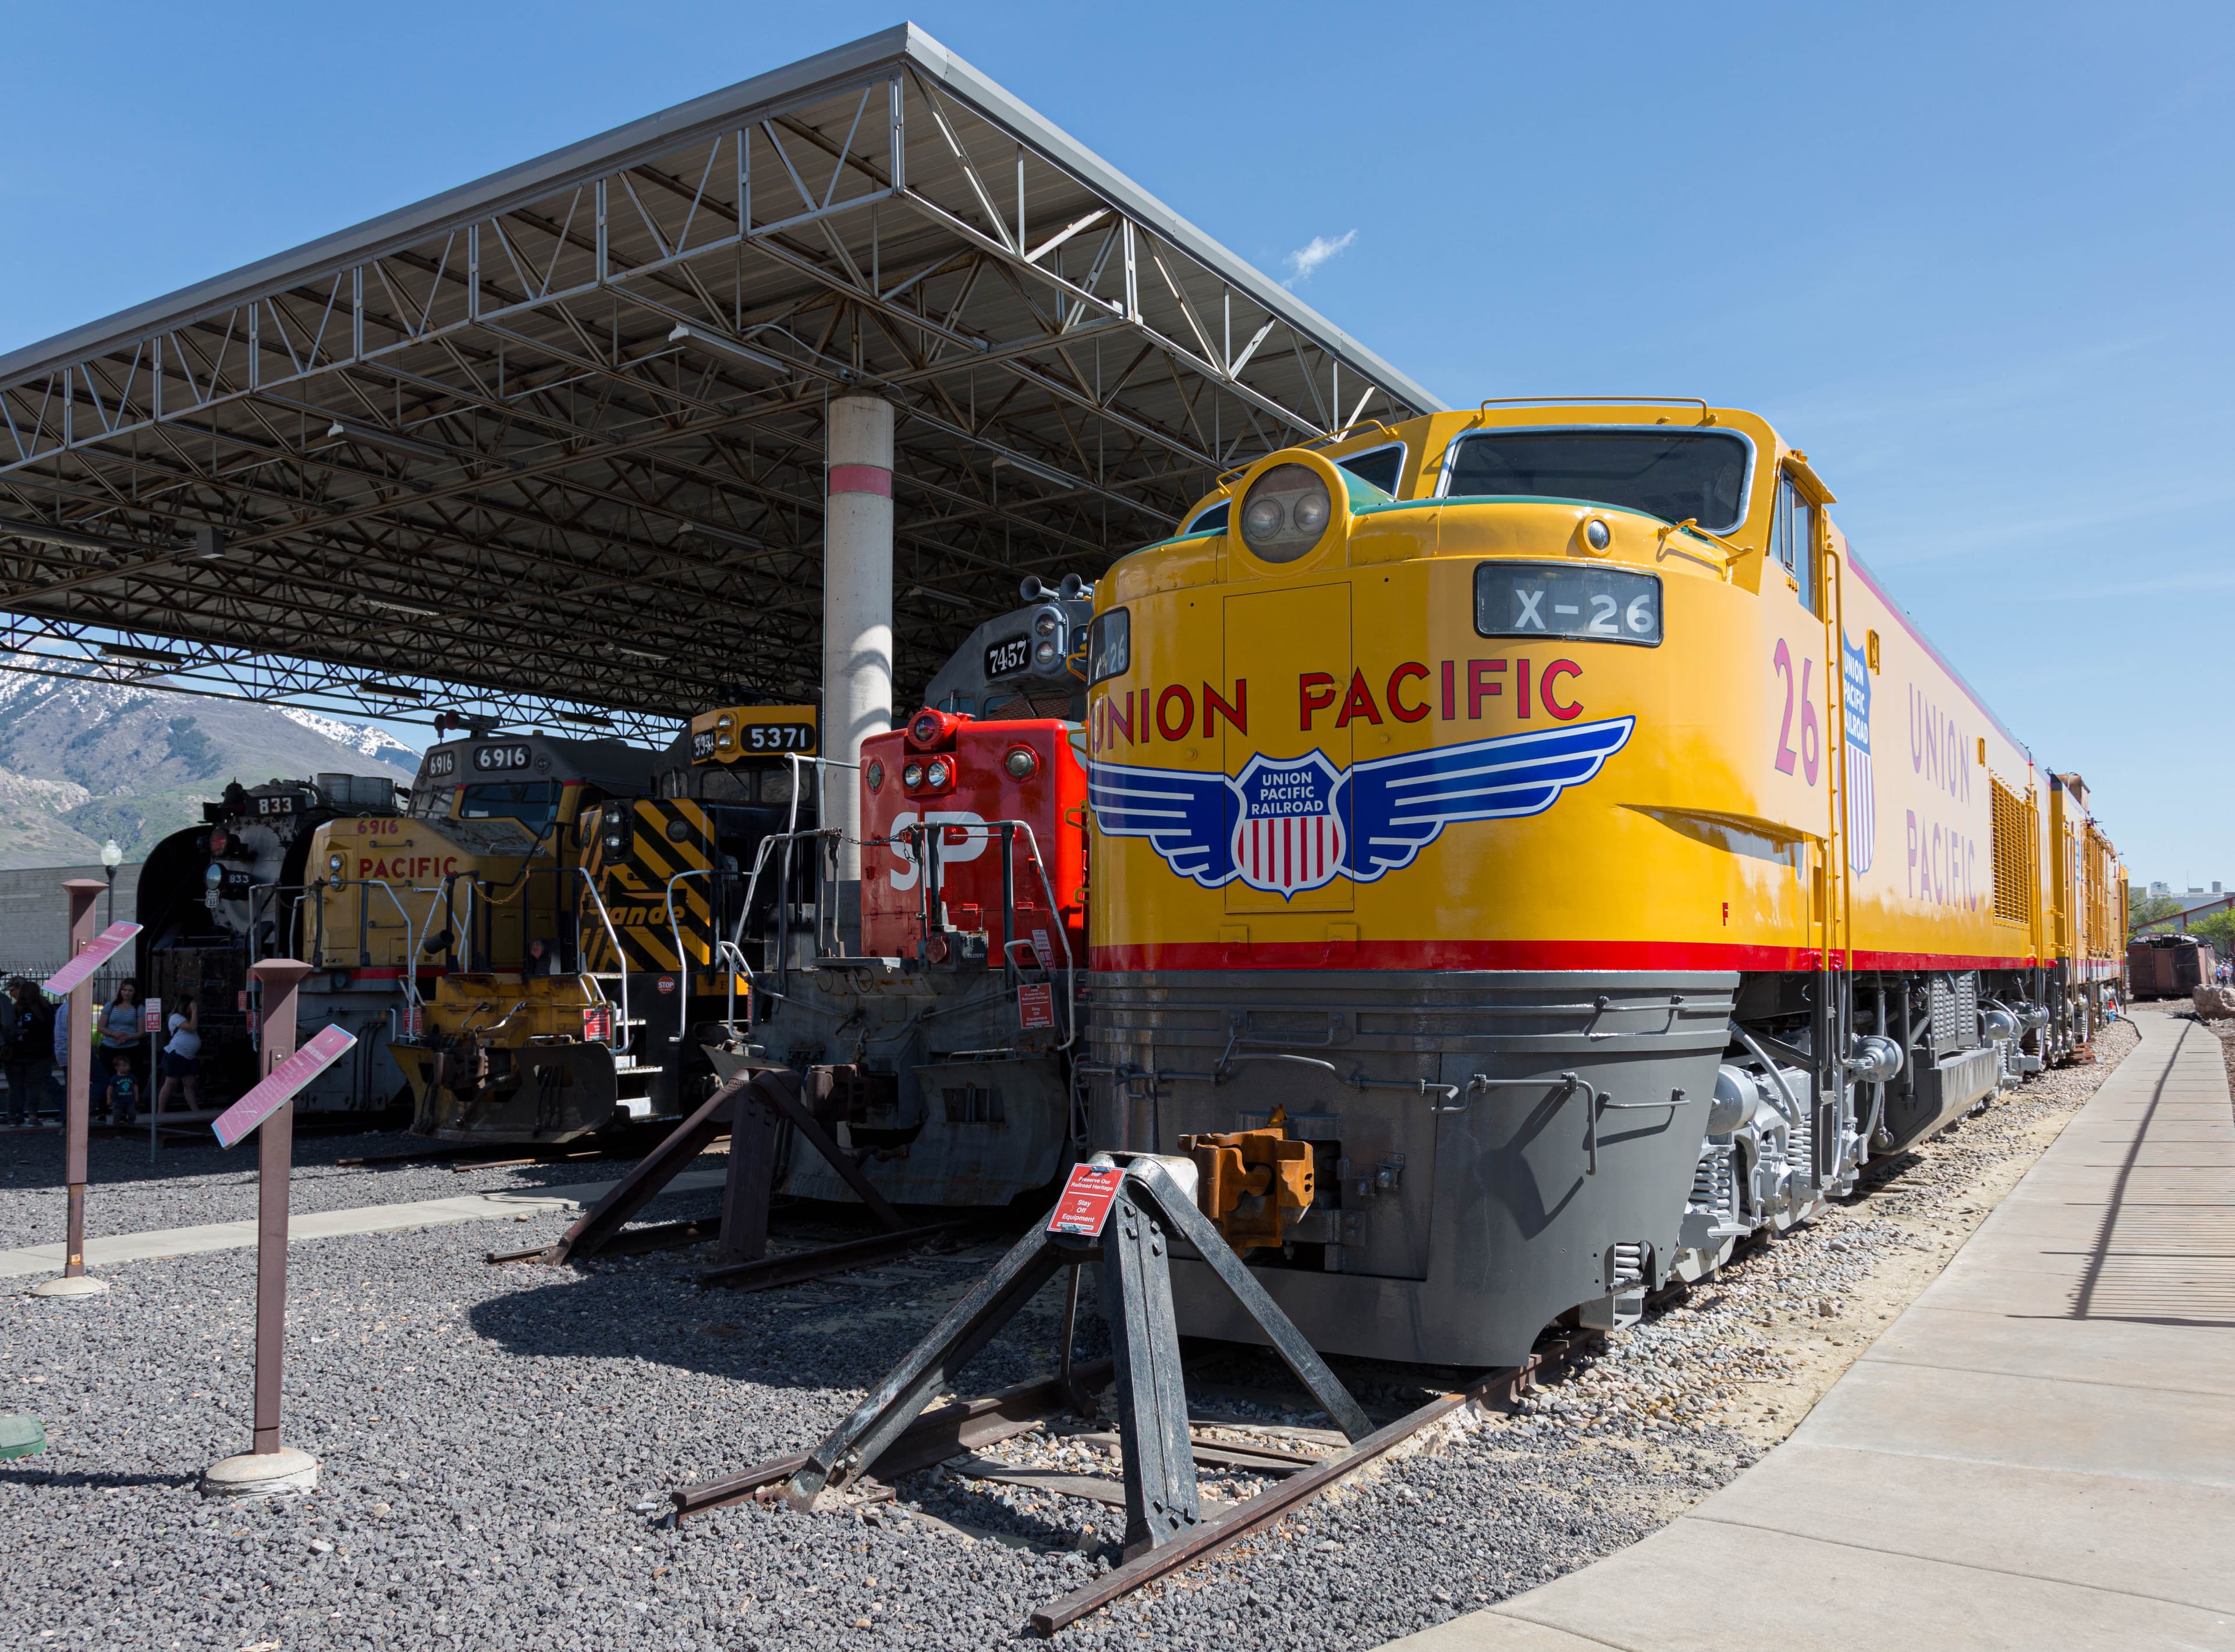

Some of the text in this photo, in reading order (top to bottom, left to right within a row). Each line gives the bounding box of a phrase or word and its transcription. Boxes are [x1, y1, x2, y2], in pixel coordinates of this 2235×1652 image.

[1514, 589, 1655, 634] X-26
[989, 640, 1027, 674] 7457
[1844, 650, 1864, 687] UNION
[1091, 659, 1584, 755] UNION PACIFIC
[1843, 678, 1865, 715] PACIFIC
[1773, 638, 1819, 787] 26
[751, 727, 806, 748] 5371
[1844, 708, 1868, 745] AILROAD
[1909, 681, 1970, 807] UNION
[430, 752, 452, 775] 6916
[480, 747, 526, 767] 6916
[1262, 772, 1312, 786] UNION
[259, 796, 292, 814] 833
[1260, 786, 1314, 801] PACIFIC
[1251, 800, 1324, 815] RAILROAD
[357, 819, 399, 834] 6916
[890, 811, 989, 891] SP
[1906, 808, 1977, 912] PACIFIC
[229, 875, 249, 883] 833
[359, 857, 458, 878] PACIFIC
[1722, 902, 1728, 926] F
[1077, 1199, 1091, 1207] Stay
[1062, 1213, 1095, 1223] Equipment
